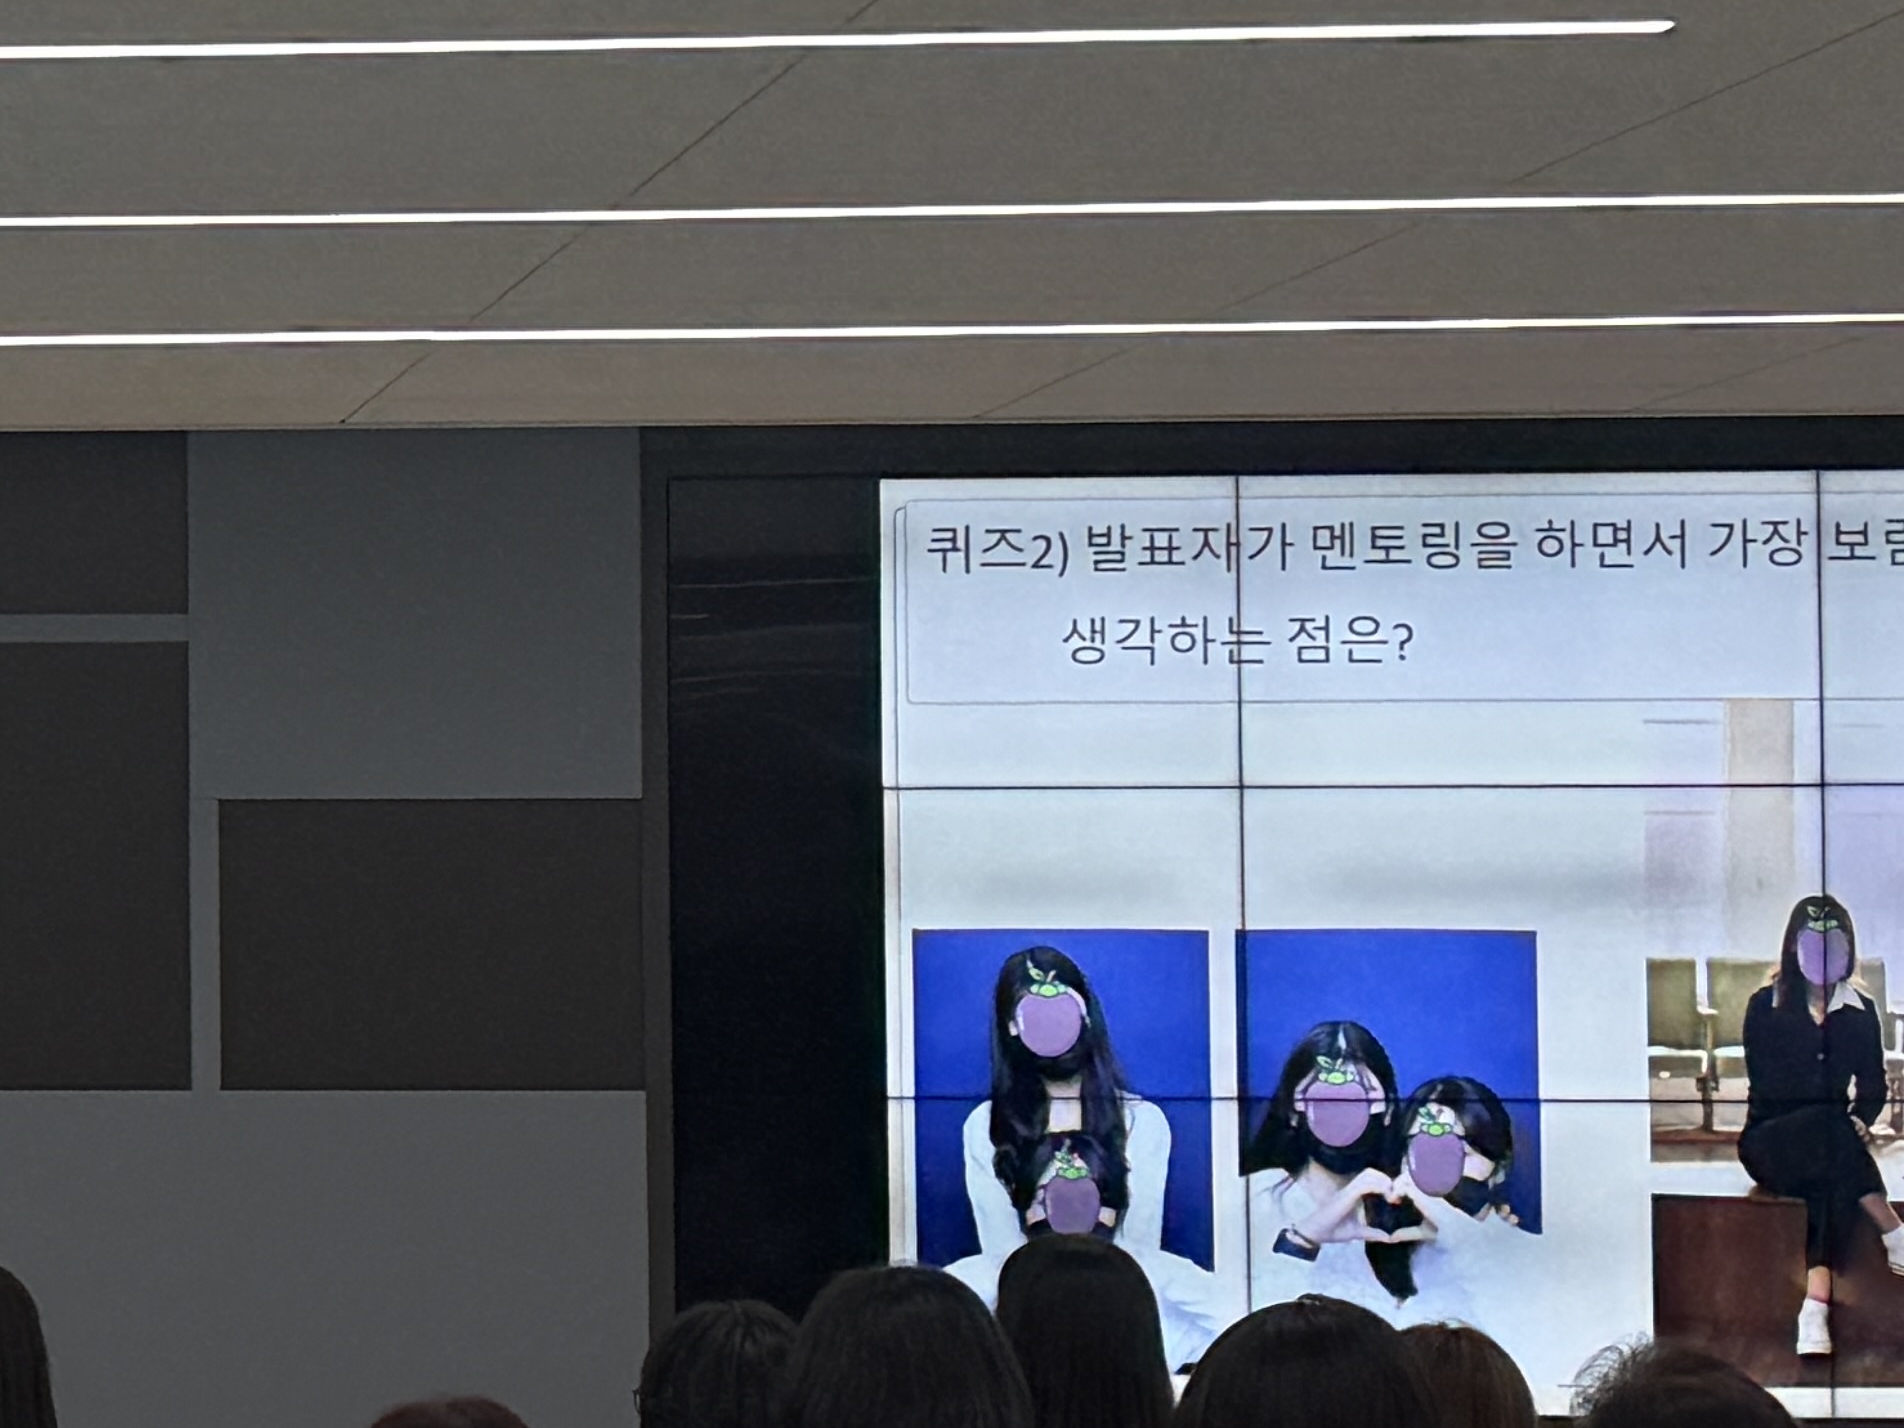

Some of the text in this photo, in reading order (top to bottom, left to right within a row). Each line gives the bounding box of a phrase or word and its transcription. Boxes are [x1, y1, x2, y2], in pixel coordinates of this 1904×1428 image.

[926, 522, 1070, 578] 퀴즈2)
[1087, 521, 1296, 573] 발표자가
[1312, 519, 1519, 572] 멘토링을
[1534, 517, 1687, 570] 하면서
[1708, 517, 1810, 569] 가장
[1062, 613, 1414, 667] 생각하는 점은?
